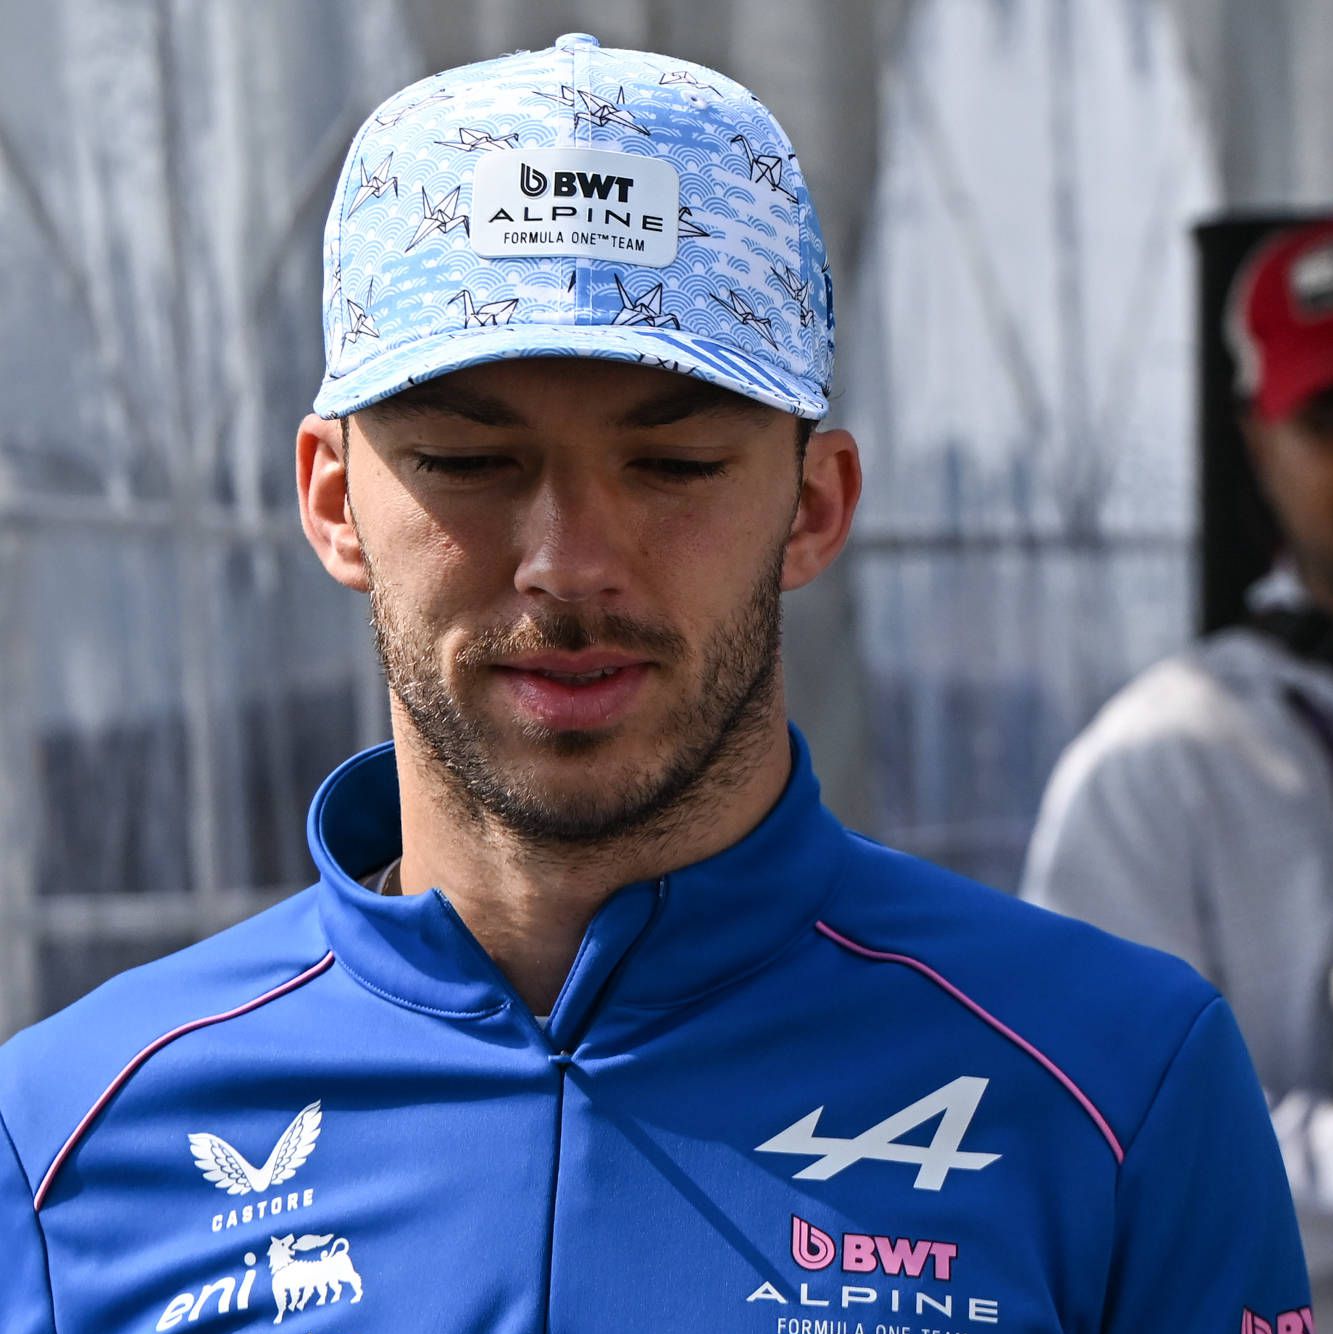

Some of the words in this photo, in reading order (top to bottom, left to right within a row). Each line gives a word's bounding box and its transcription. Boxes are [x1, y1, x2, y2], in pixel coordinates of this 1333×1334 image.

[553, 171, 634, 203] BWT
[488, 206, 663, 233] ALPINE
[503, 231, 564, 245] FORMULA
[611, 235, 645, 252] TEAM
[211, 1187, 315, 1233] CASTORE
[841, 1232, 958, 1282] BWT
[155, 1252, 257, 1332] eni
[745, 1281, 999, 1325] ALPINE
